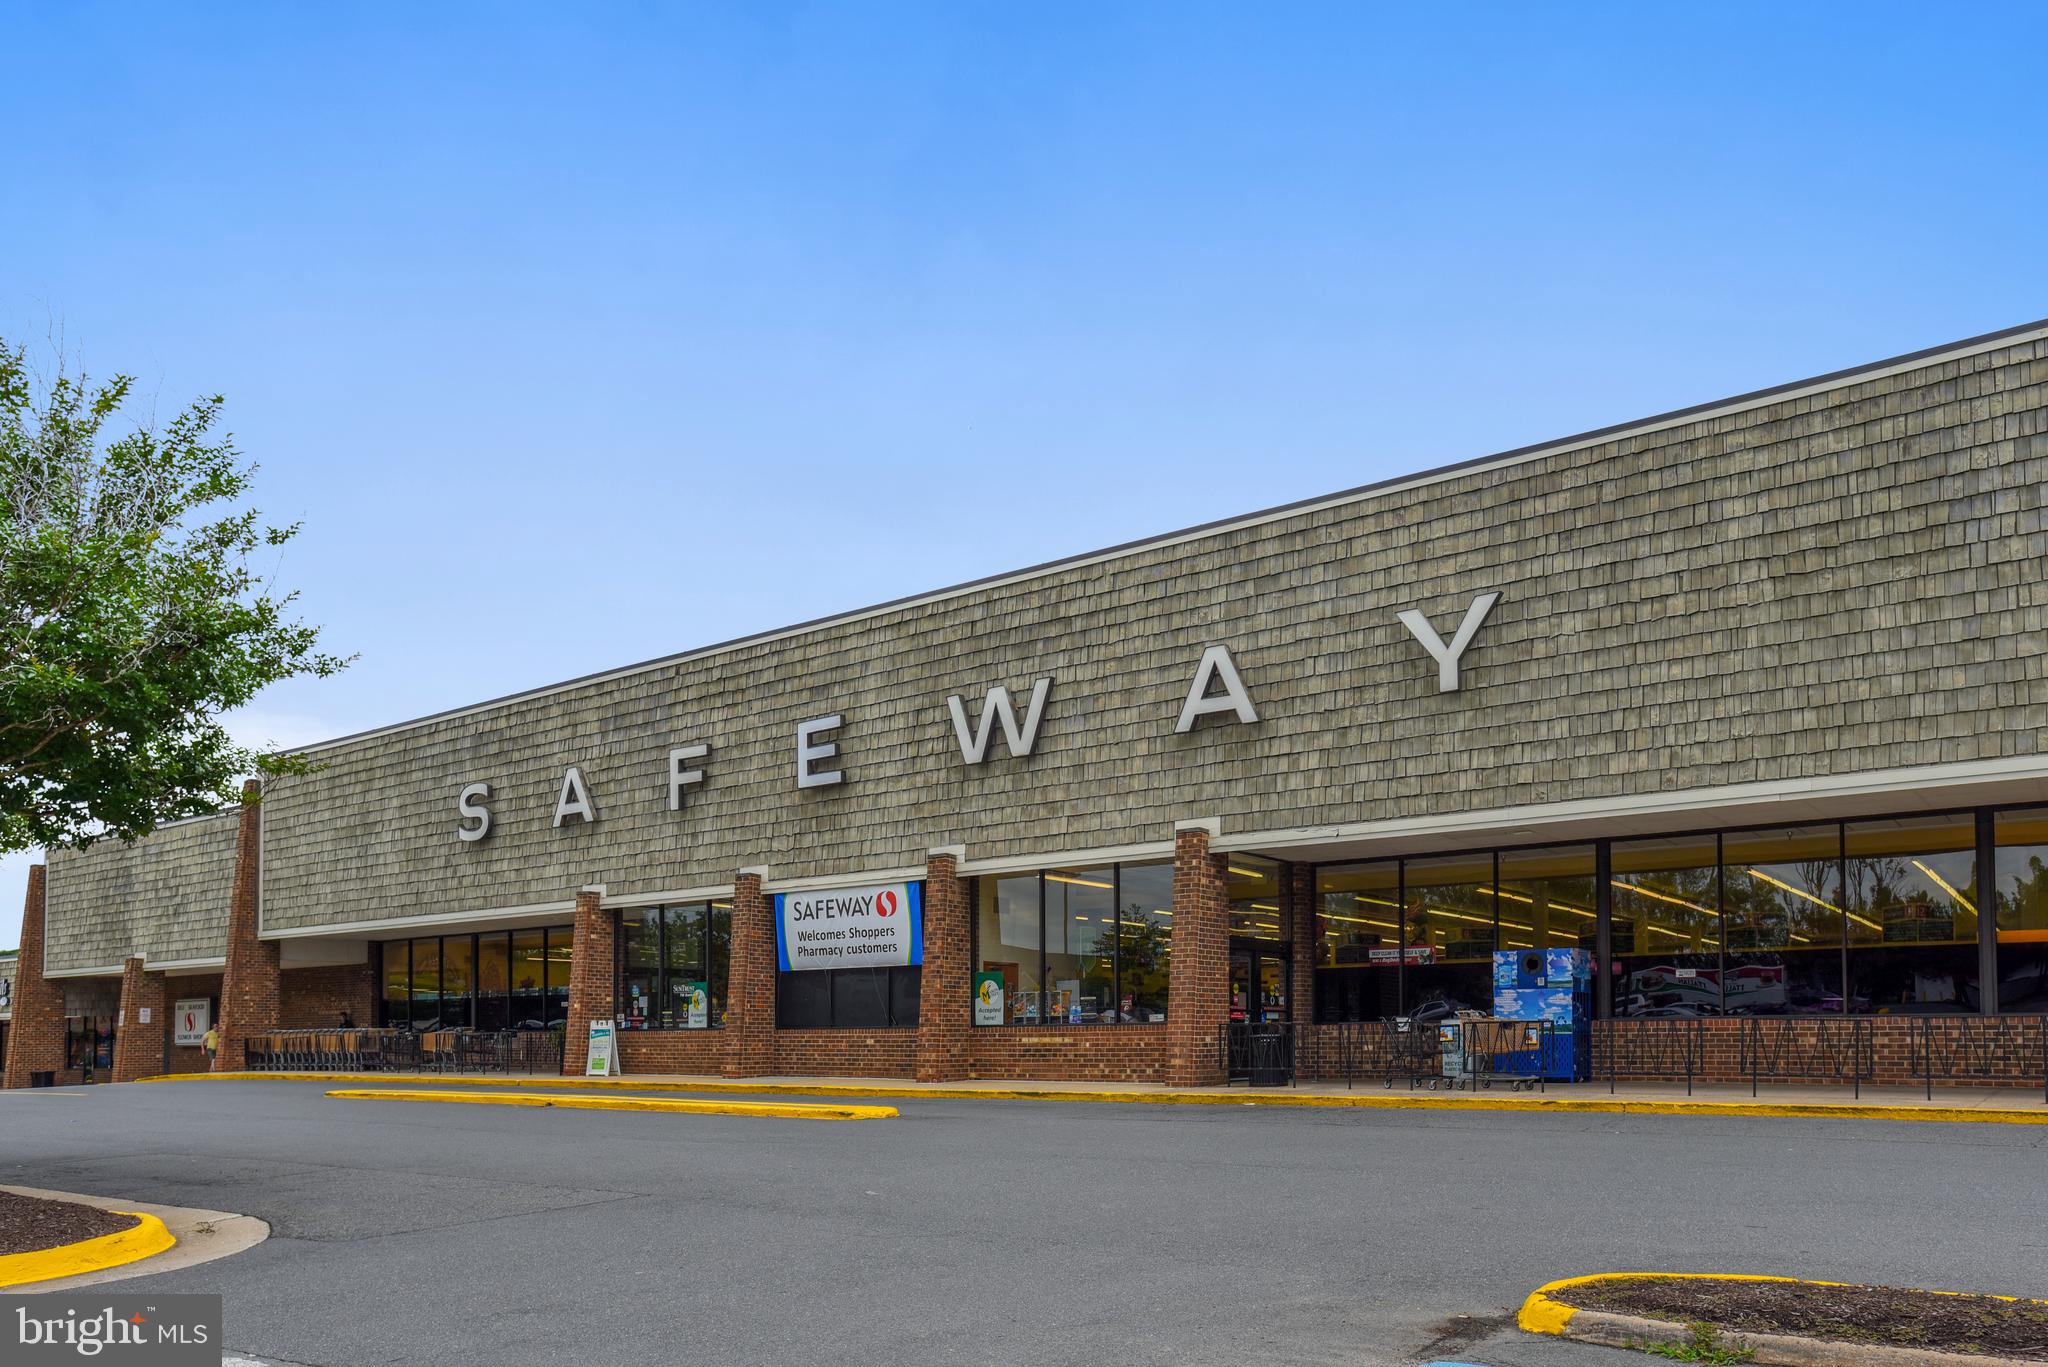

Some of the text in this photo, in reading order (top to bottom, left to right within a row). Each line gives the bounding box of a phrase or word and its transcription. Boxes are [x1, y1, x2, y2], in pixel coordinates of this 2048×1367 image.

[457, 591, 1504, 843] SAFEWAY
[793, 895, 873, 922] SAFEWAY
[797, 926, 895, 942] Welcomes Shoppers
[797, 943, 898, 958] Pharmacy customers
